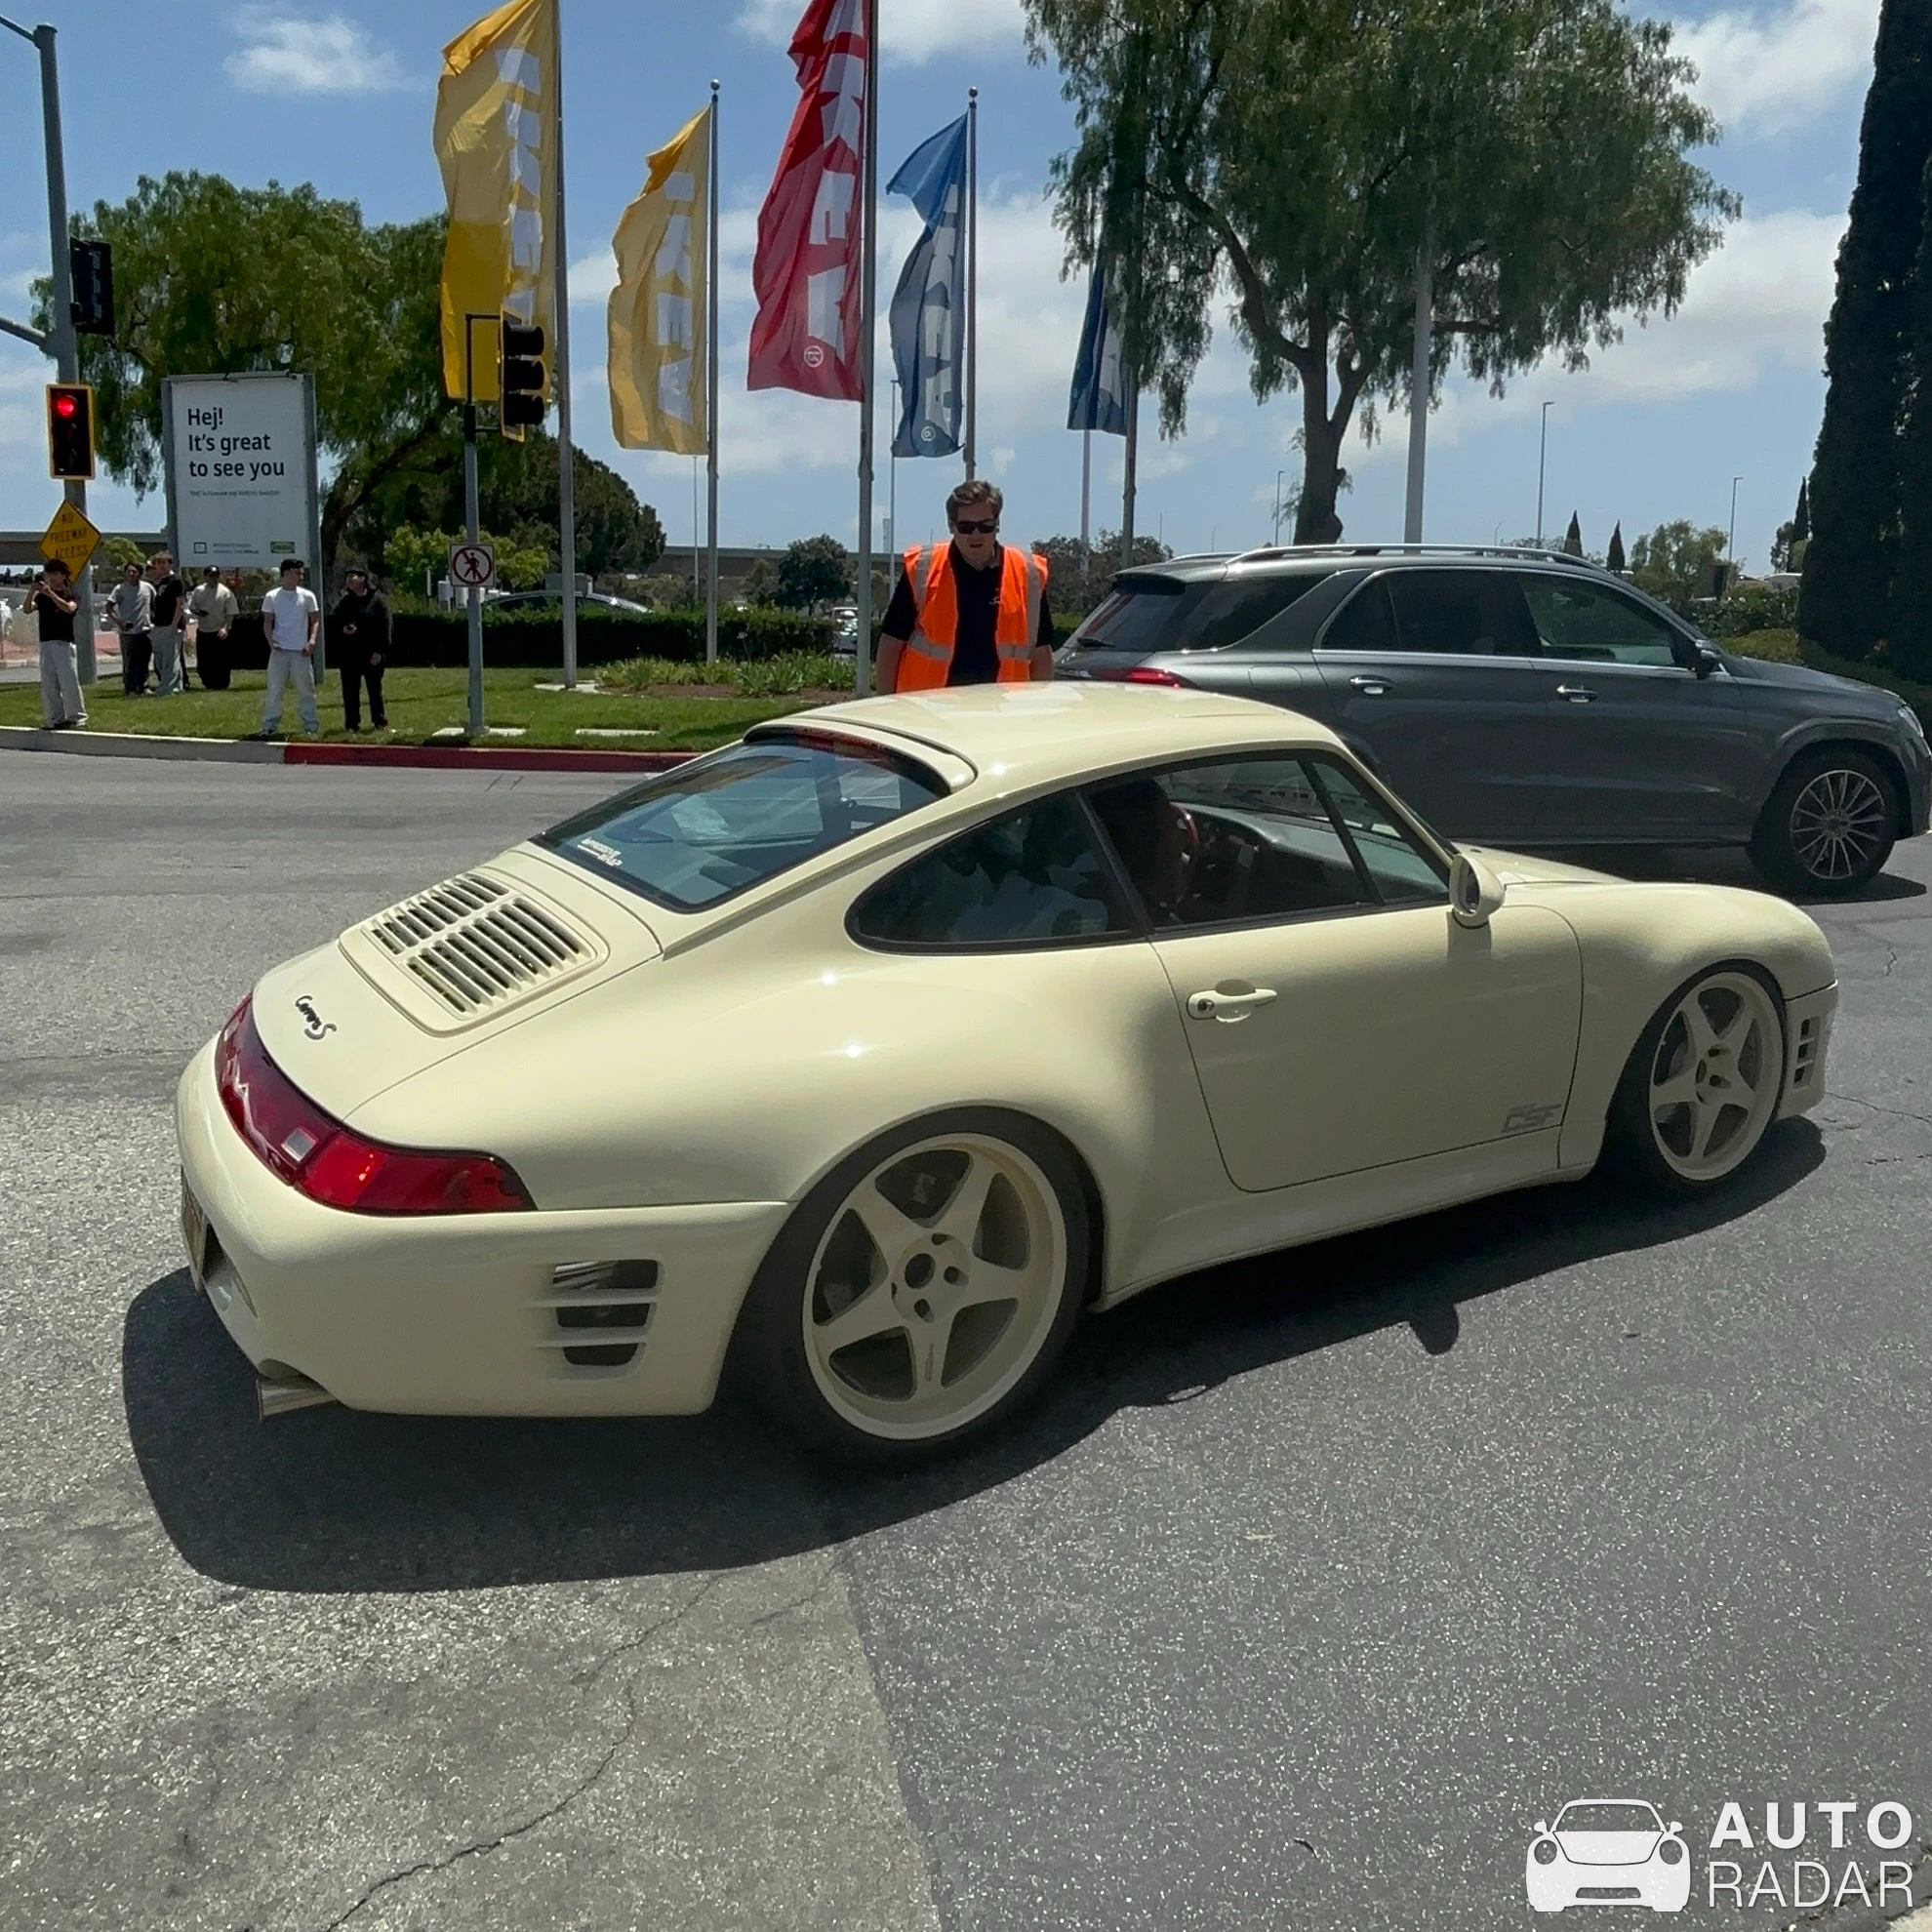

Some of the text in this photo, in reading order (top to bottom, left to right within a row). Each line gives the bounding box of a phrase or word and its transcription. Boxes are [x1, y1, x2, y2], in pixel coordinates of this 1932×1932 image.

[187, 407, 223, 431] Hej!
[188, 433, 271, 456] It's great
[189, 461, 285, 482] to see you
[61, 512, 74, 524] NO
[50, 528, 88, 543] FREEWAY
[55, 544, 89, 559] ACCESS
[304, 1024, 337, 1041] S
